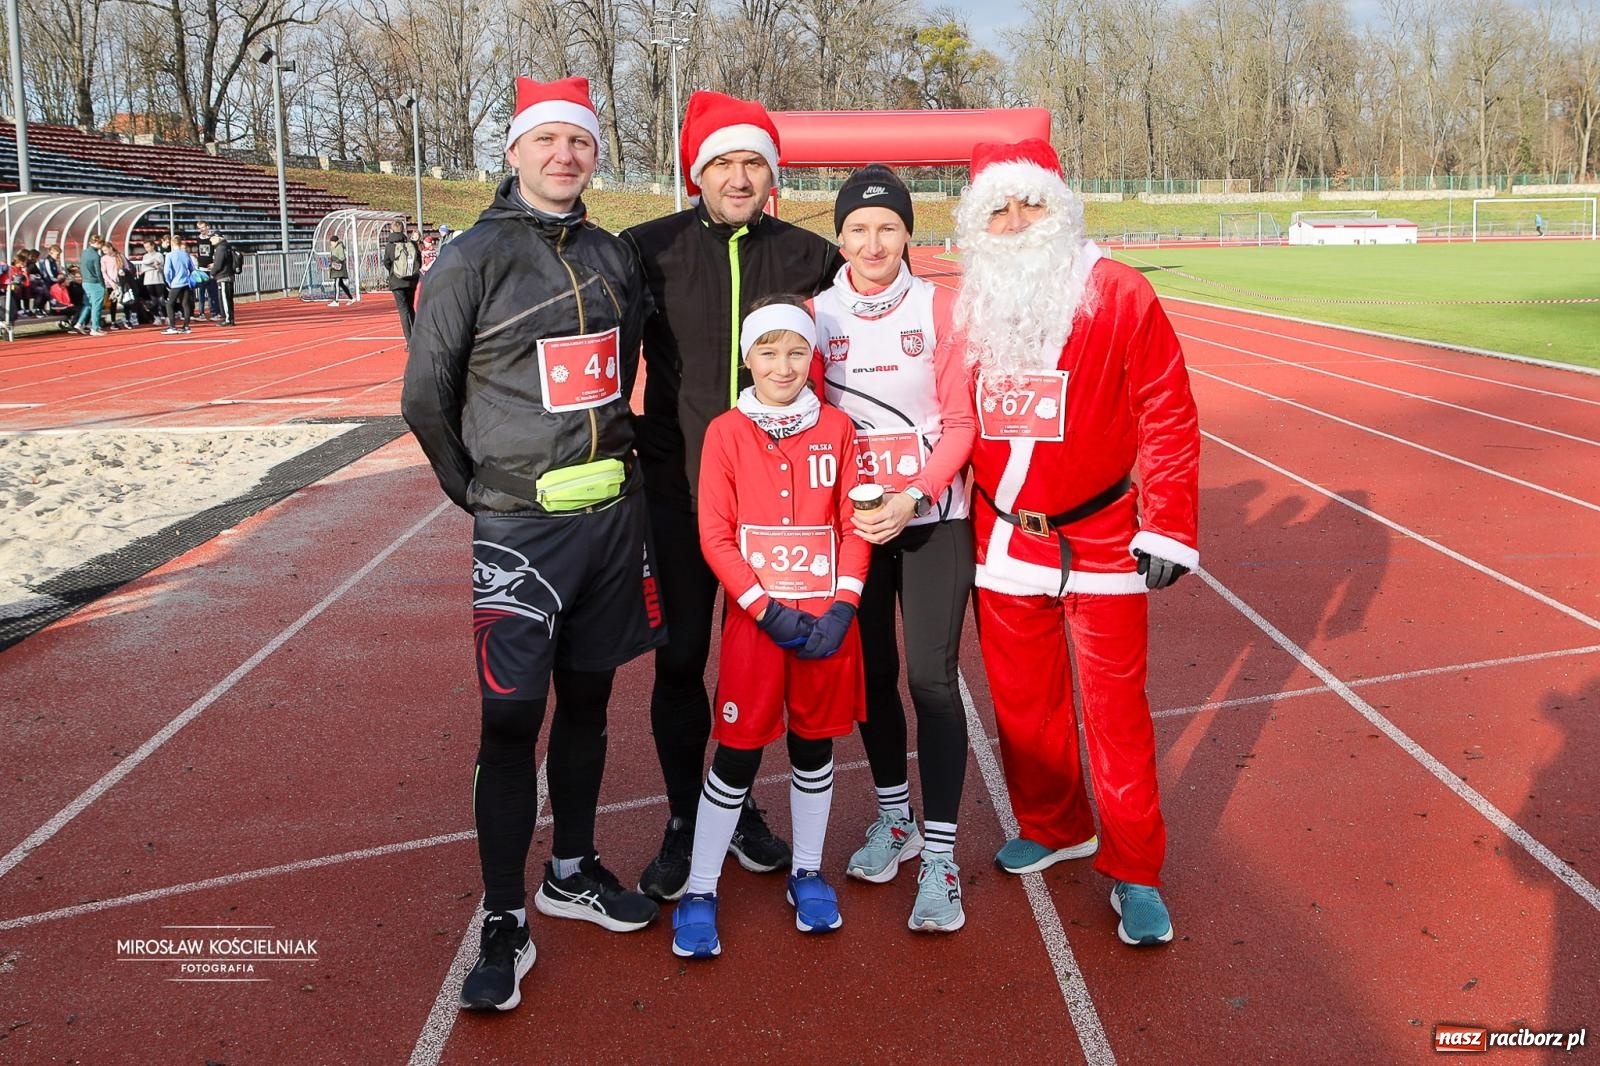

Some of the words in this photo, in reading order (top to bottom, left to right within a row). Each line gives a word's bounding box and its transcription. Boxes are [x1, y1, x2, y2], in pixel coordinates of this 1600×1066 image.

[866, 186, 886, 194] RUN
[584, 353, 601, 380] 4
[1001, 390, 1036, 416] 67
[808, 443, 833, 451] POLSKA
[806, 454, 837, 489] 10
[770, 544, 809, 572] 32
[722, 701, 739, 724] 9
